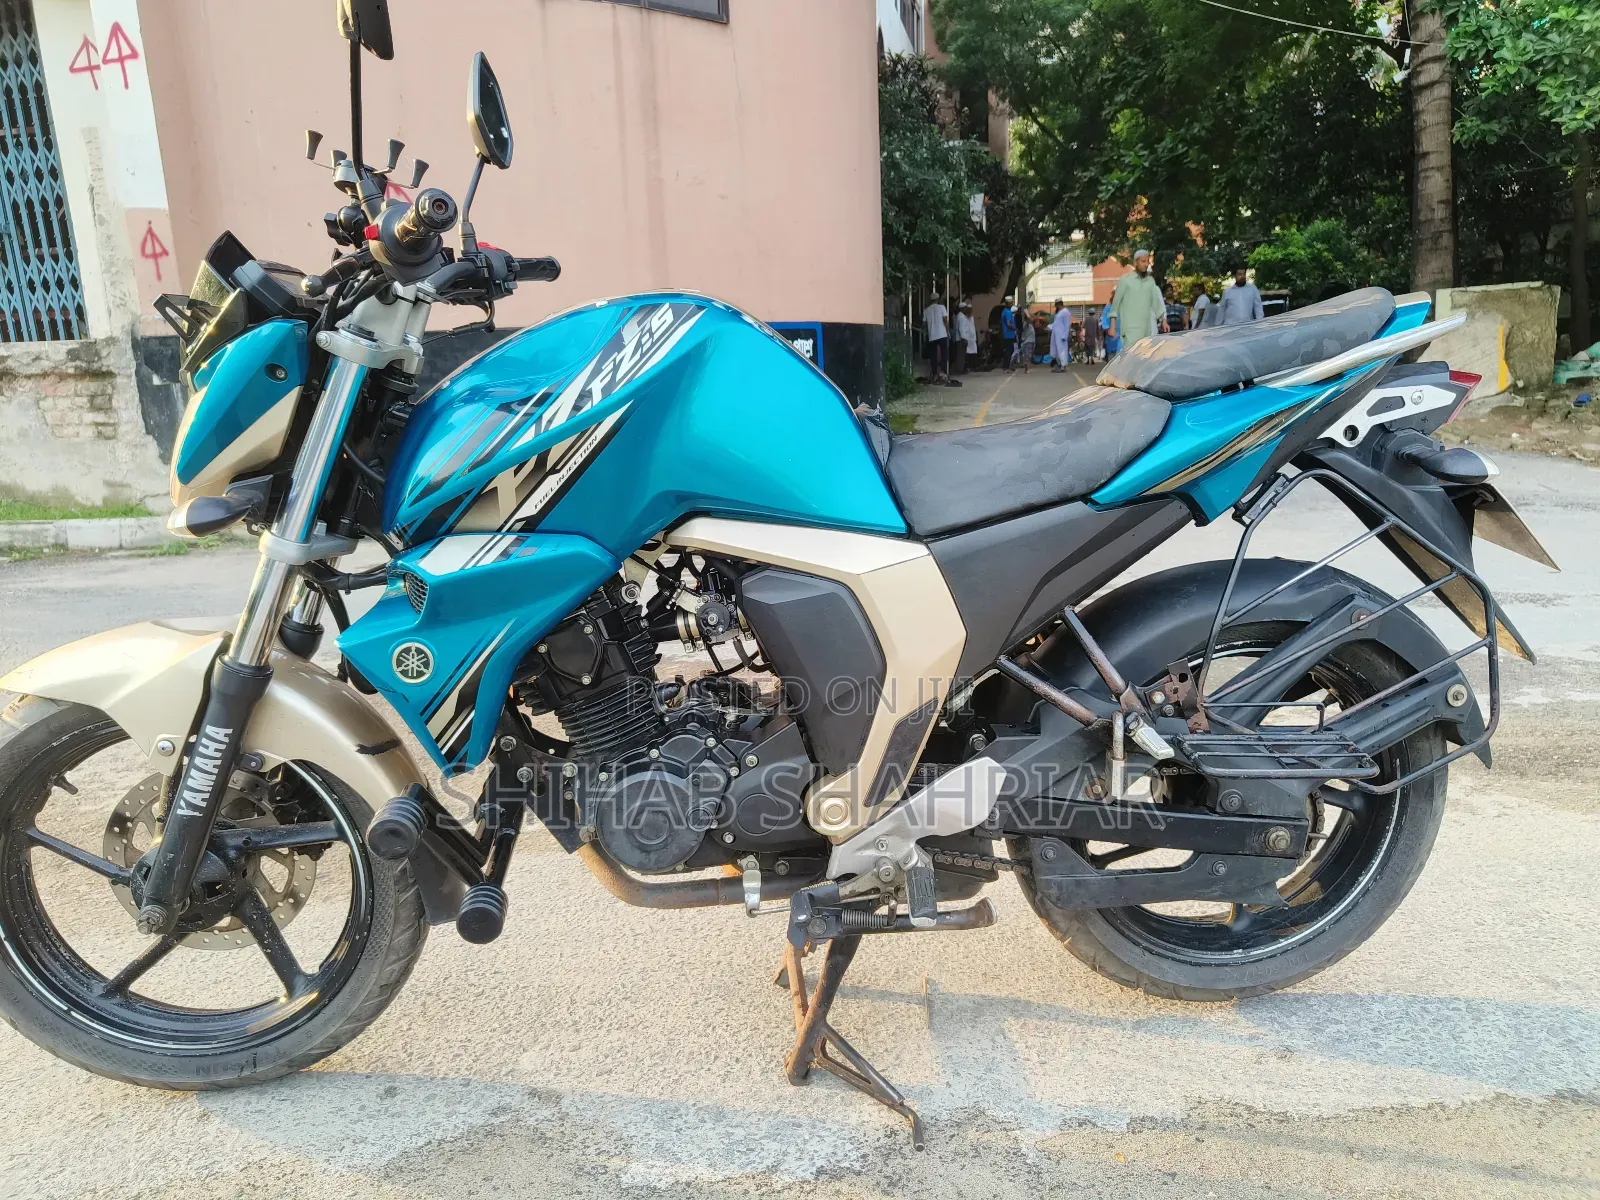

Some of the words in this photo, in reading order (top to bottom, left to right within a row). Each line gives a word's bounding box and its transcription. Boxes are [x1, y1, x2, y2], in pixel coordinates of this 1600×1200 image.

[534, 486, 557, 510] FUEL
[556, 434, 598, 486] INJECTION
[176, 724, 233, 817] YAMAHA
